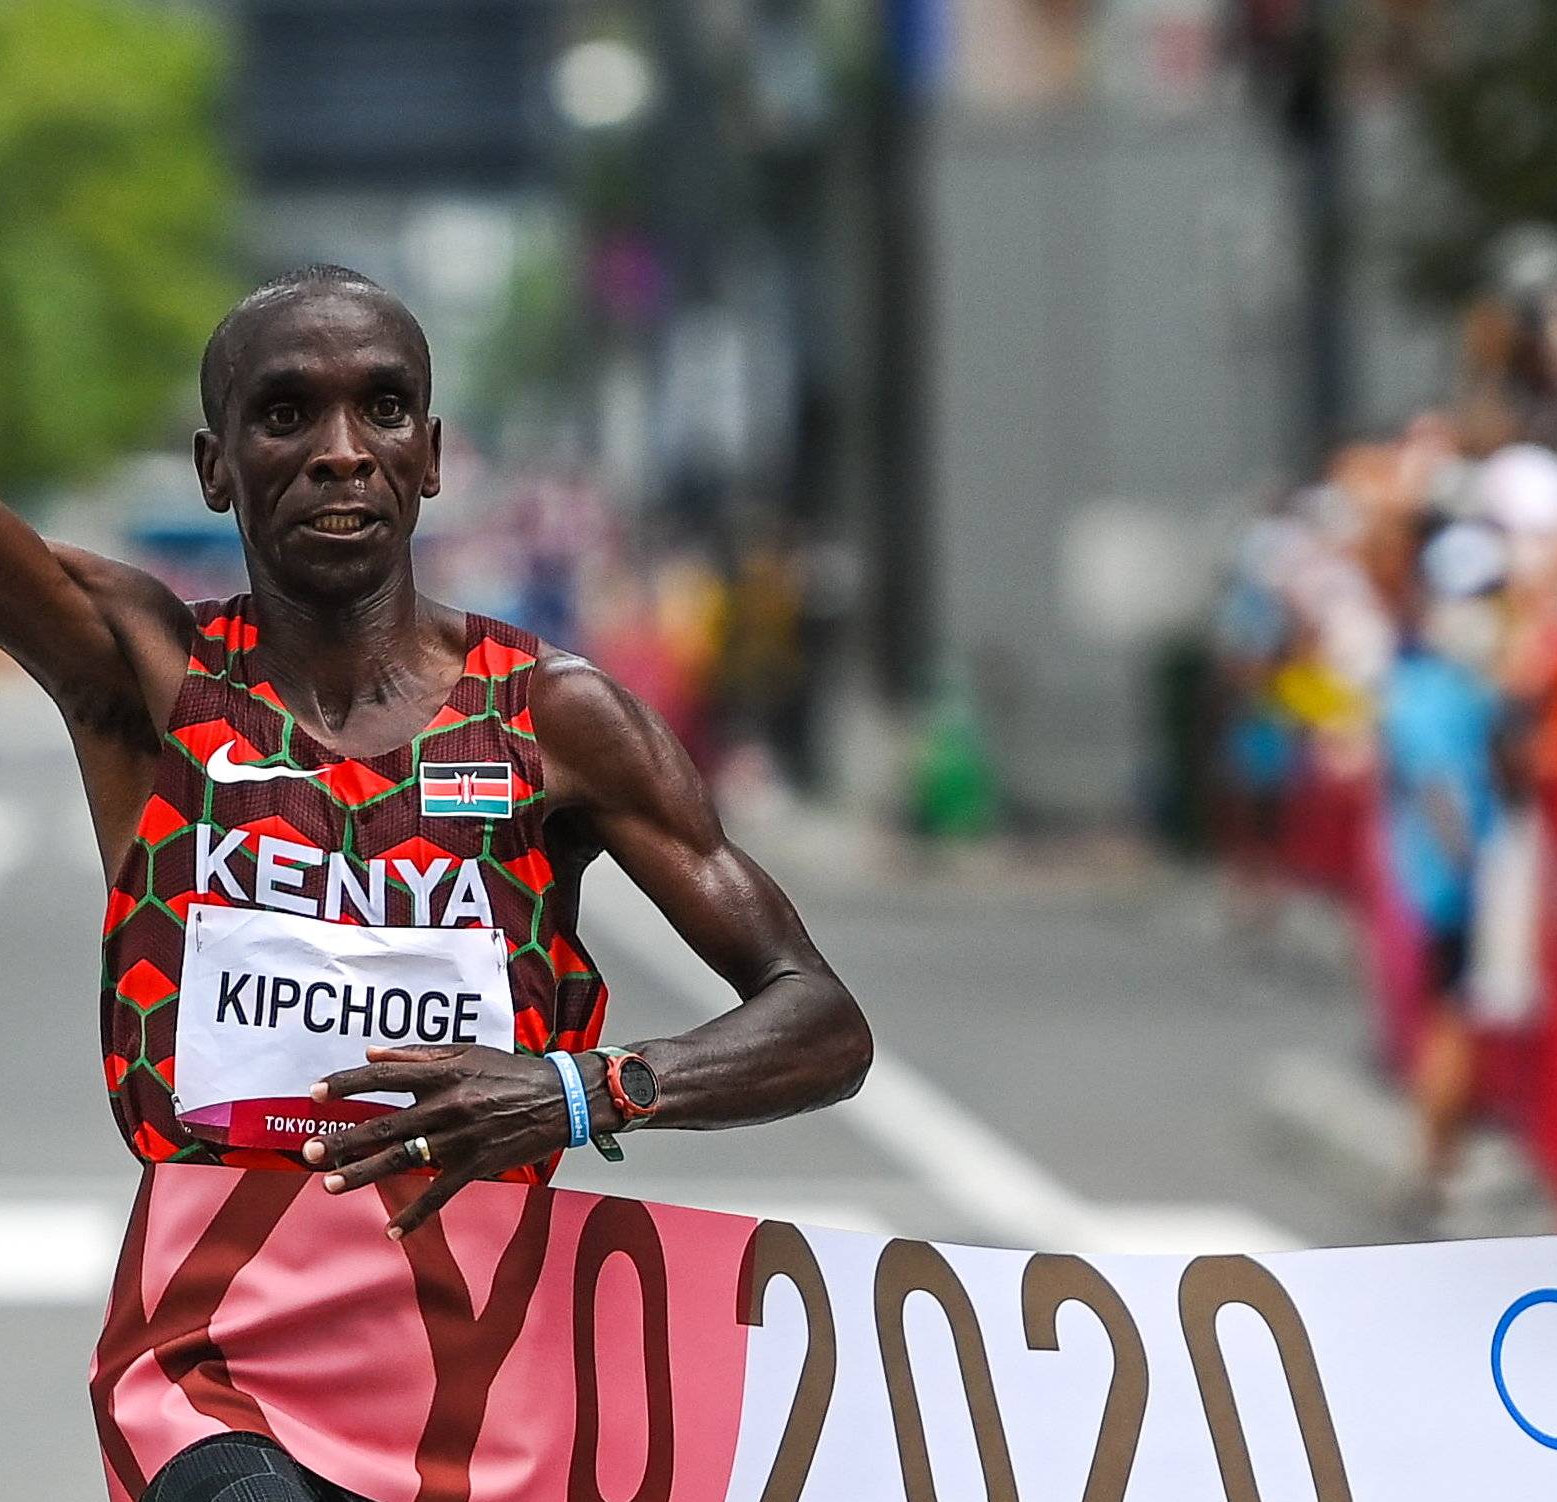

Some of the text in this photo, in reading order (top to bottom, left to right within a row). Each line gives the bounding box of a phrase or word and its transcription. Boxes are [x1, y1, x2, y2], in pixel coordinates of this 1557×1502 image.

[195, 823, 494, 928] KENYA
[216, 971, 482, 1044] KIPCHOGE
[265, 1115, 316, 1134] TOKYO
